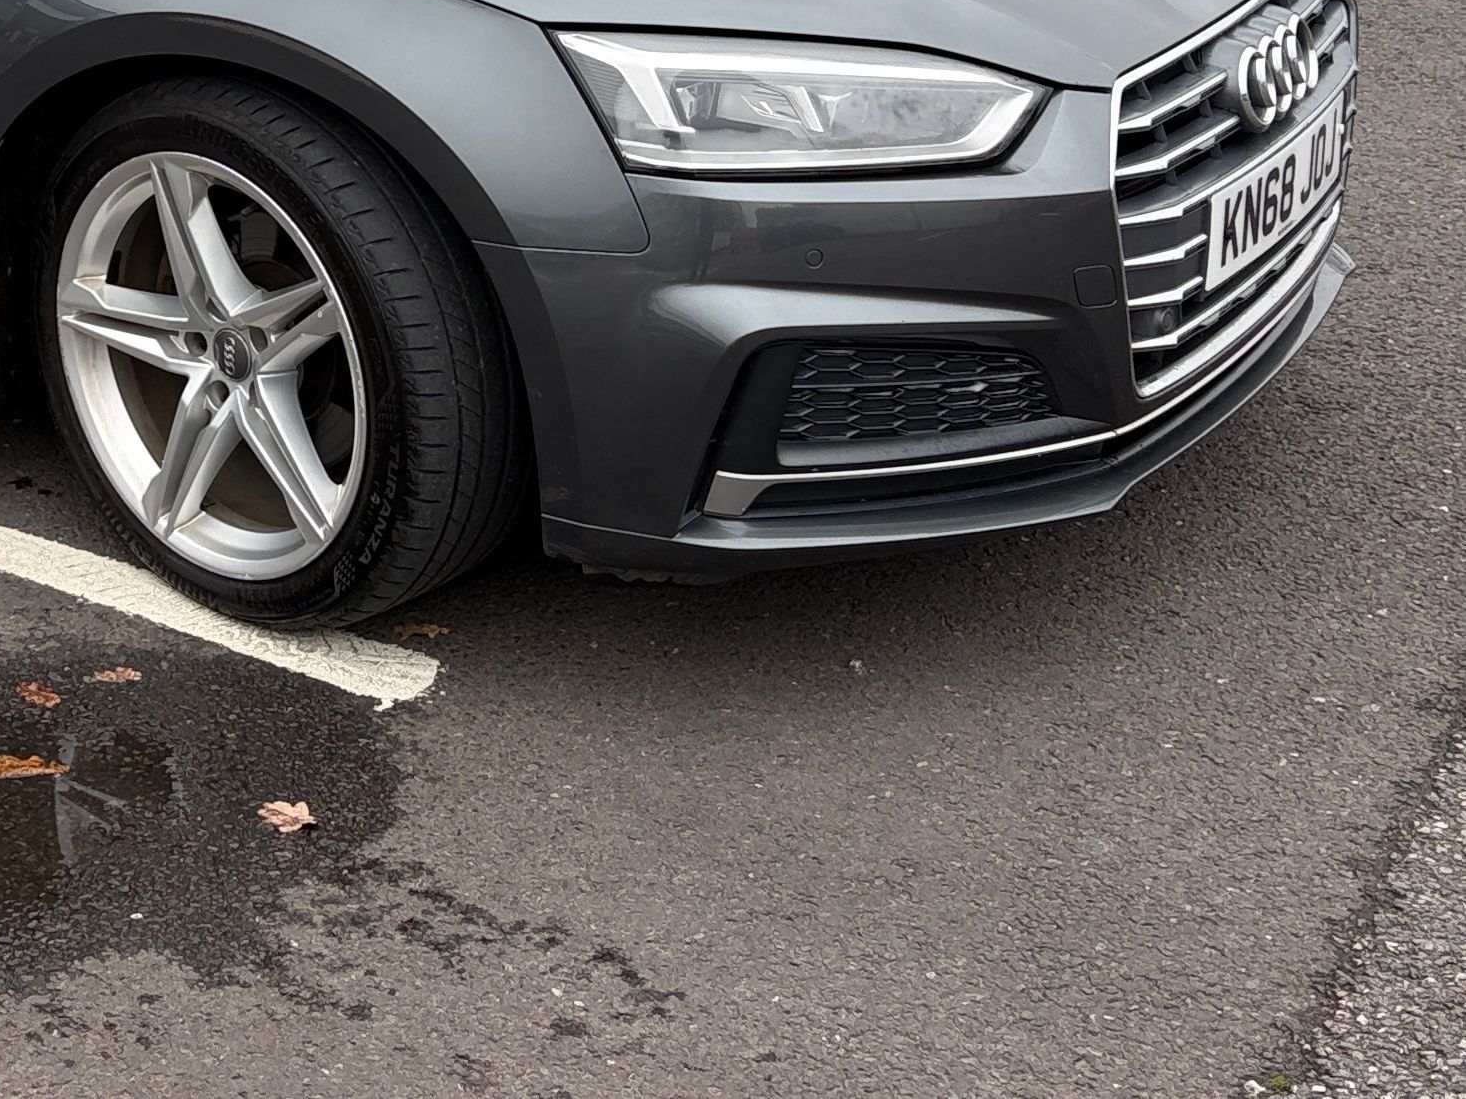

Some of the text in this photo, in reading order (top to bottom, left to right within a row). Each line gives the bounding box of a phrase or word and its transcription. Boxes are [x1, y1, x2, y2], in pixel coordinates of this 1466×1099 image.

[1220, 107, 1338, 269] KN68 JOJ
[358, 442, 401, 566] TURANZA
